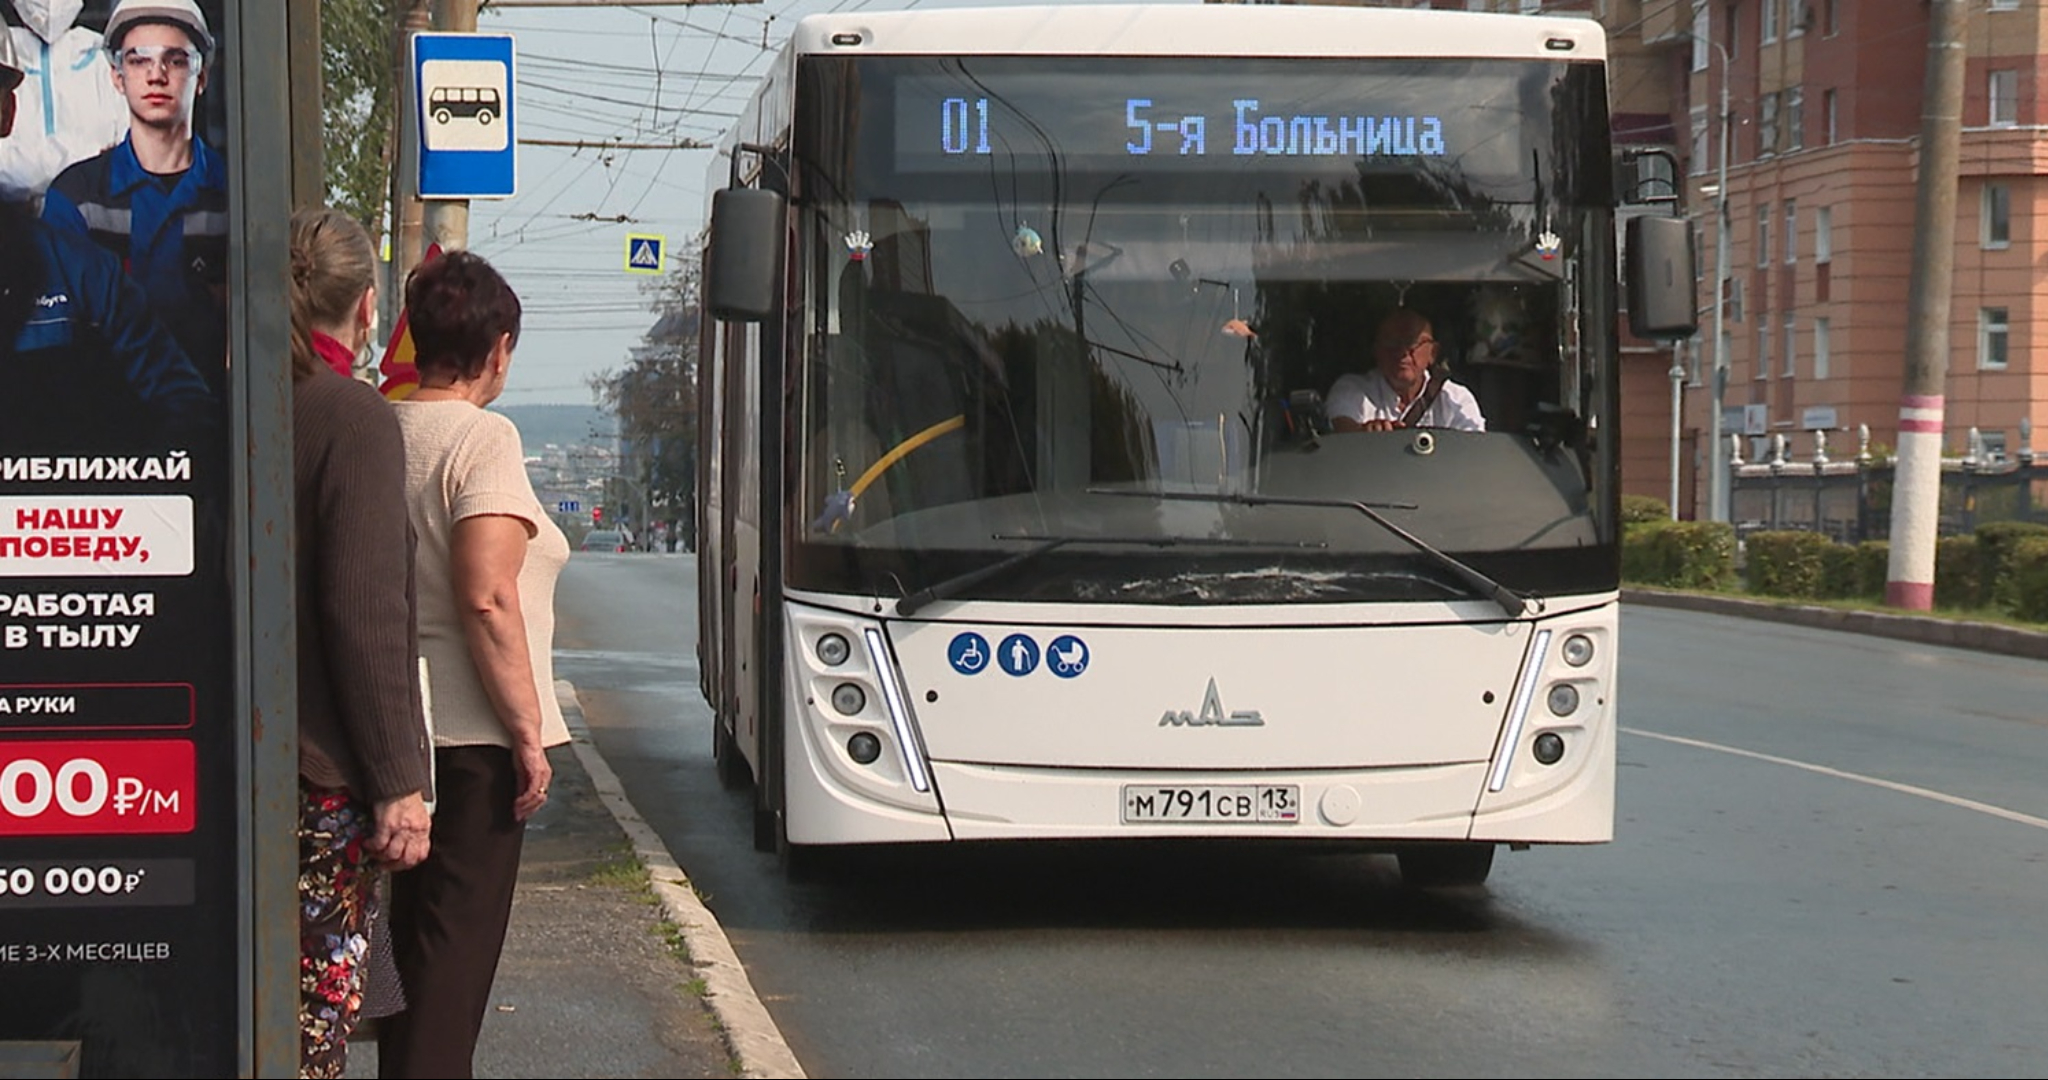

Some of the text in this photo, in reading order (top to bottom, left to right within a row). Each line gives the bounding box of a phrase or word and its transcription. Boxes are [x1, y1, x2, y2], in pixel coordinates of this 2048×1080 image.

[941, 98, 1446, 156] 01 5-я Больница
[0, 450, 192, 481] ИБЛИЖАЙ
[16, 508, 124, 530] НАШУ
[0, 536, 150, 563] ПОБЕДУ,
[5, 624, 141, 648] В ТЫЛУ
[16, 696, 75, 714] РУКИ
[1262, 787, 1289, 810] 13
[26, 944, 61, 961] 3-Х
[67, 942, 170, 963] МЕСЯЦЕВ
